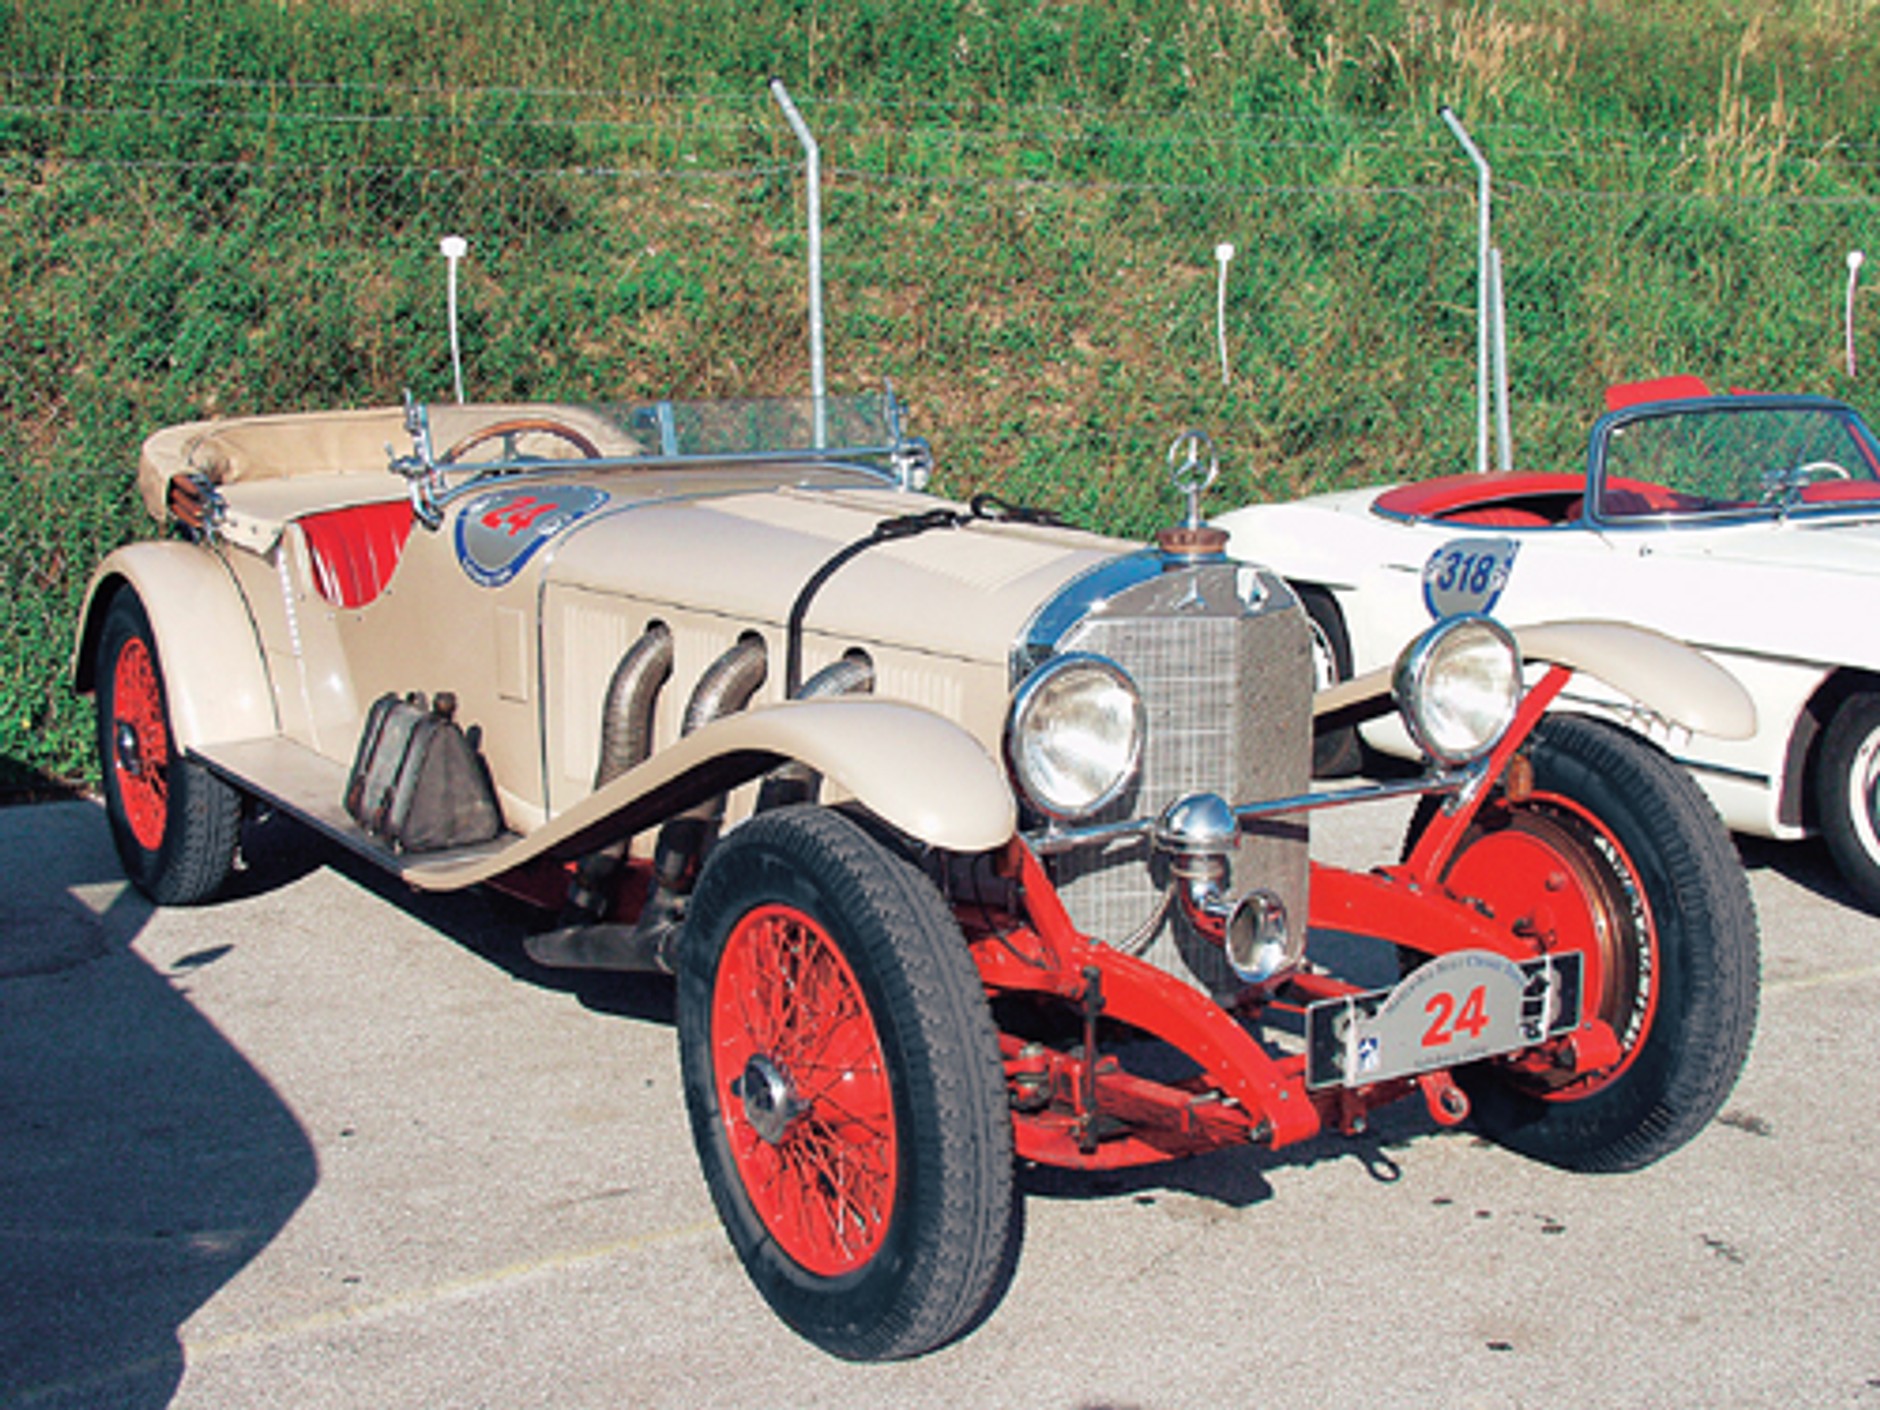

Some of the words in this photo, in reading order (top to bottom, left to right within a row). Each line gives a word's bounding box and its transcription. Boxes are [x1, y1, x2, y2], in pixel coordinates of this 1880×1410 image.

[482, 496, 559, 536] 24
[1438, 551, 1495, 594] 318
[1421, 985, 1489, 1047] 24
